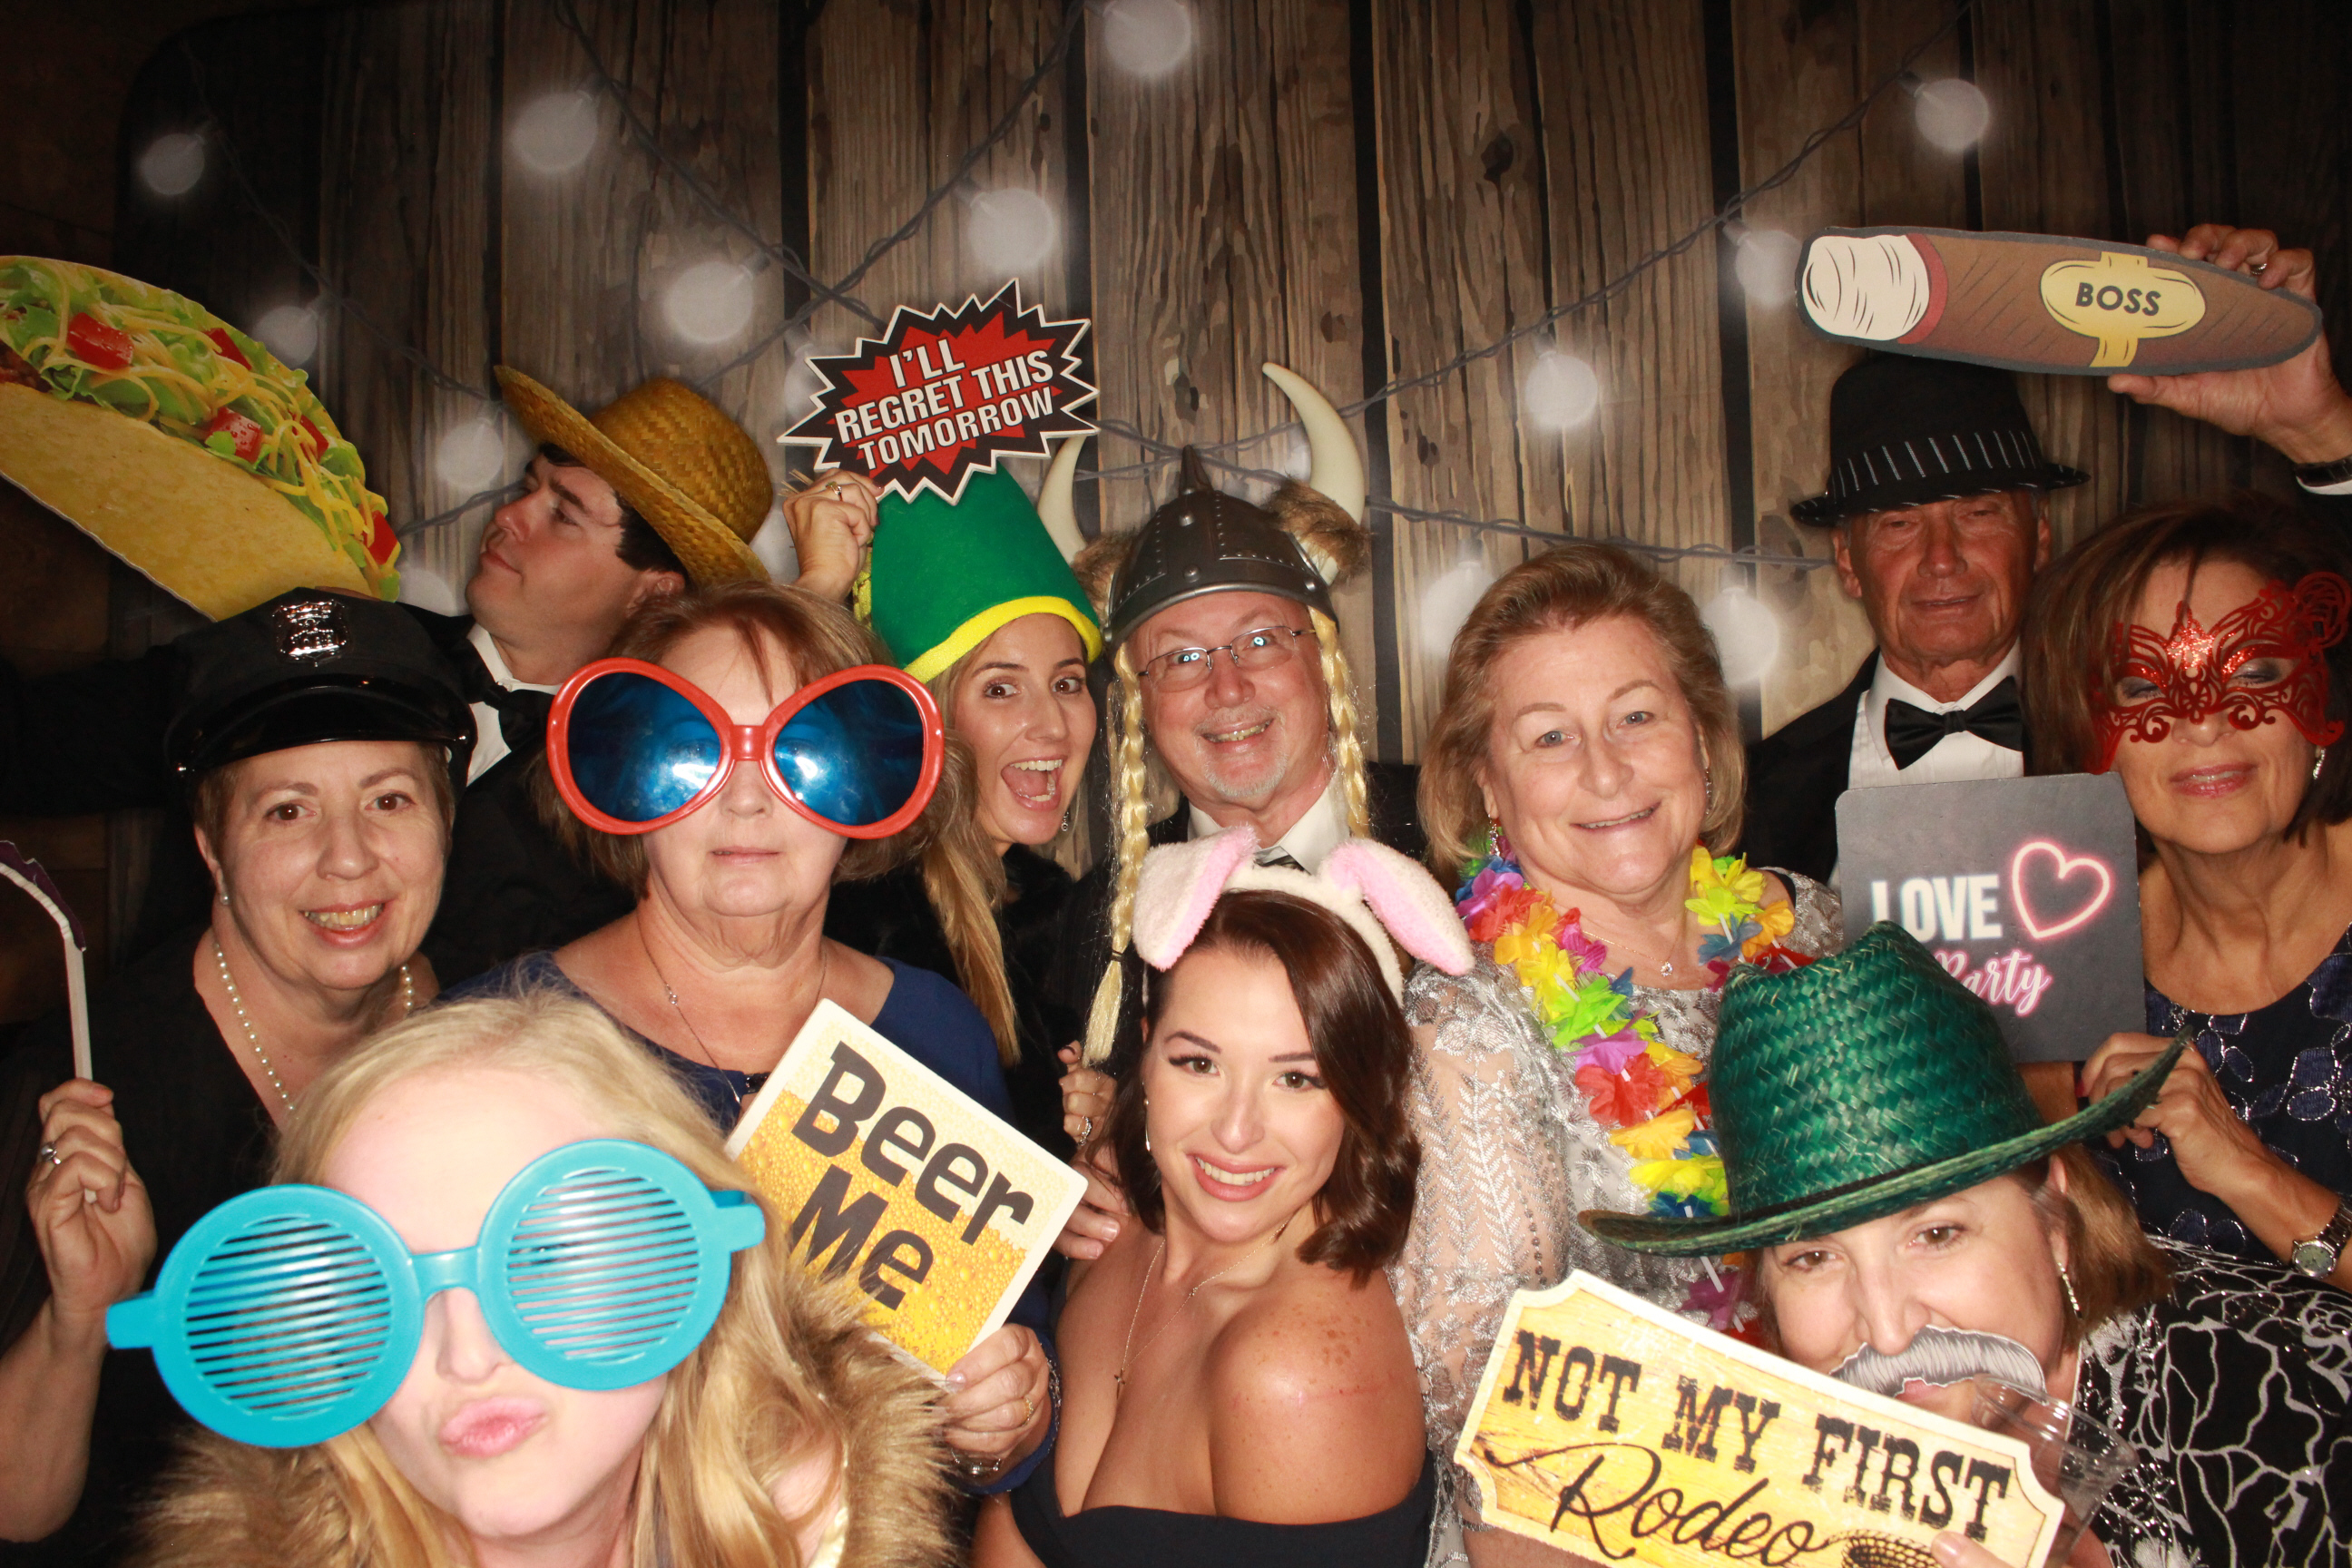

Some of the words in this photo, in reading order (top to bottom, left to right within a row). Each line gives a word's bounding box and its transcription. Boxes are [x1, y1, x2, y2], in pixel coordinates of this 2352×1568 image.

[2075, 282, 2161, 316] BOSS
[835, 375, 964, 444] REGRET
[972, 350, 1054, 400] THIS
[889, 339, 965, 387] I'LL
[858, 387, 1053, 470] TOMORROW
[790, 1041, 1034, 1246] Beer
[789, 1164, 934, 1311] Me
[1502, 1329, 1642, 1432] NOT
[1661, 1375, 1781, 1473] MY
[1802, 1411, 2012, 1542] FIRST
[1482, 1442, 1829, 1567] Rodeo
